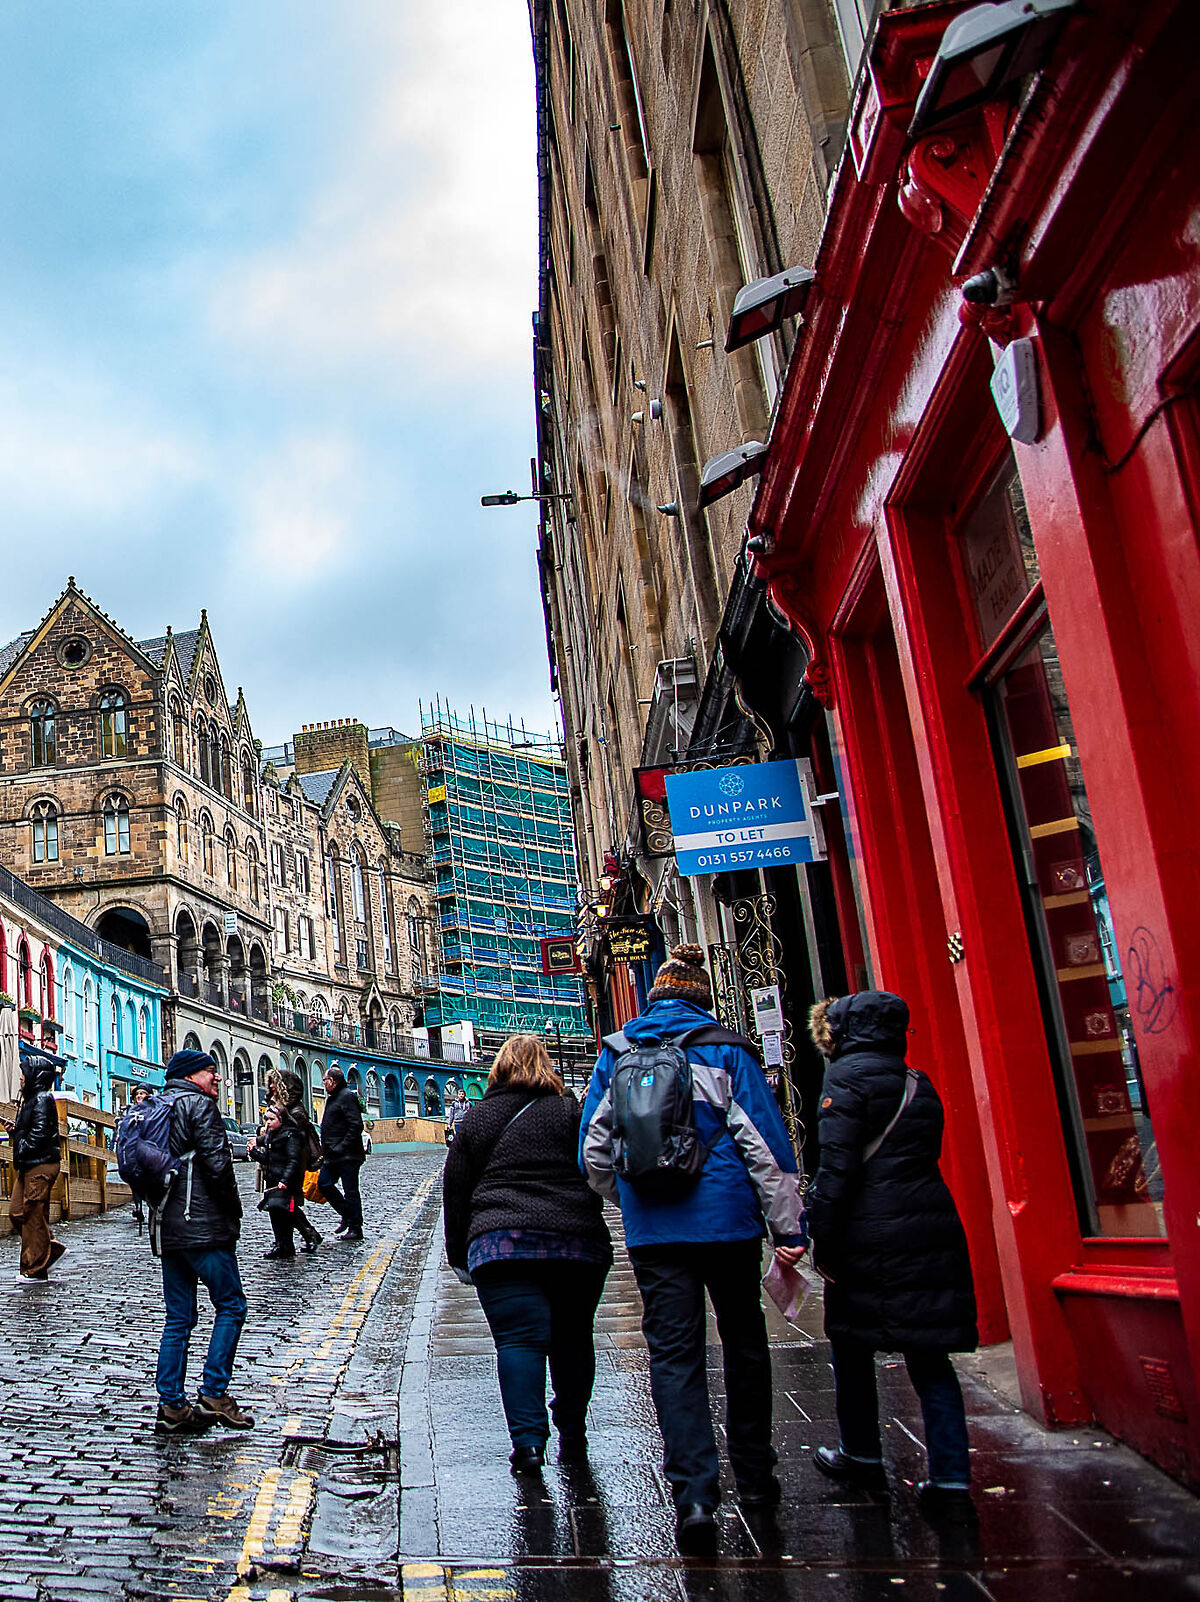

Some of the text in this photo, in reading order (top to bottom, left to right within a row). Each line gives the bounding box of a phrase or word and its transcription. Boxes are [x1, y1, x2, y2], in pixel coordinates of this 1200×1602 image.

[689, 796, 782, 819] DUNPARK
[707, 814, 768, 826] PROPERTY AGENTS
[716, 829, 765, 844] TO LET
[698, 846, 791, 867] 0131 557 4466
[608, 930, 619, 941] The
